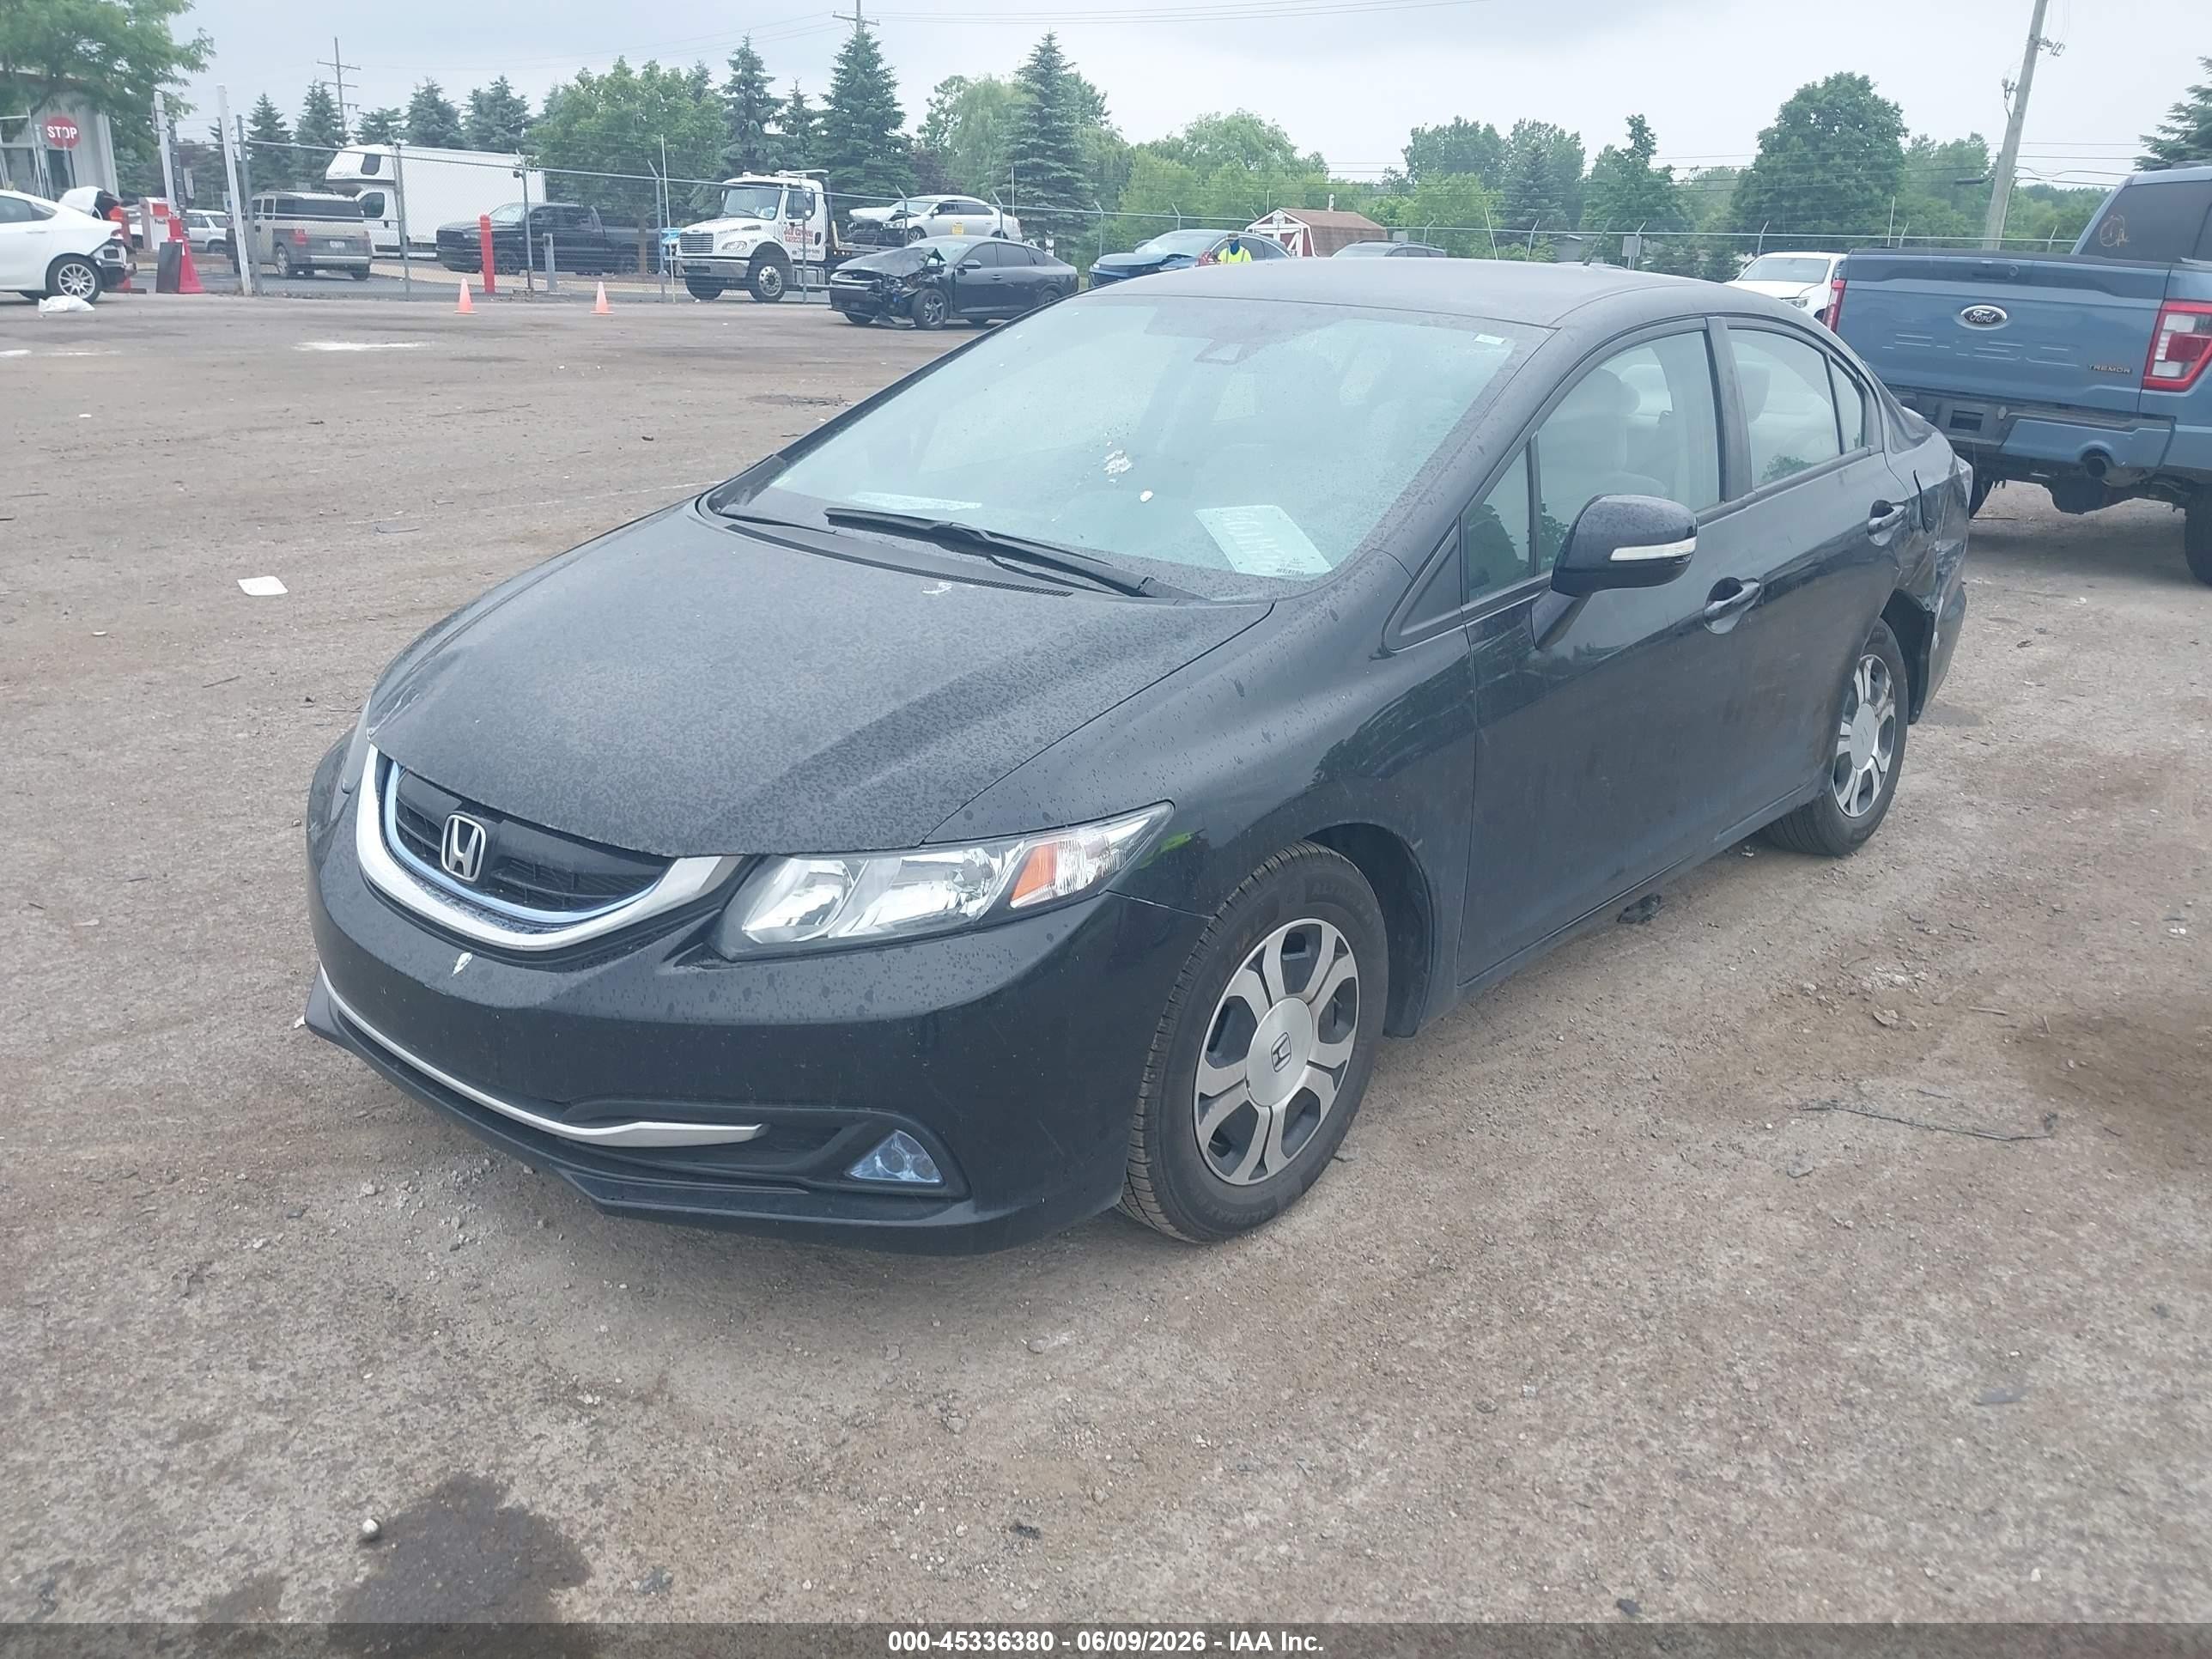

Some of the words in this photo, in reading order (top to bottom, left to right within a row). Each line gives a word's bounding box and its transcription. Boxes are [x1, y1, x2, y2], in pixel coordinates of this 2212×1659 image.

[47, 125, 77, 139] STOP
[1969, 309, 1996, 324] Ford
[2087, 364, 2131, 374] TREMOR
